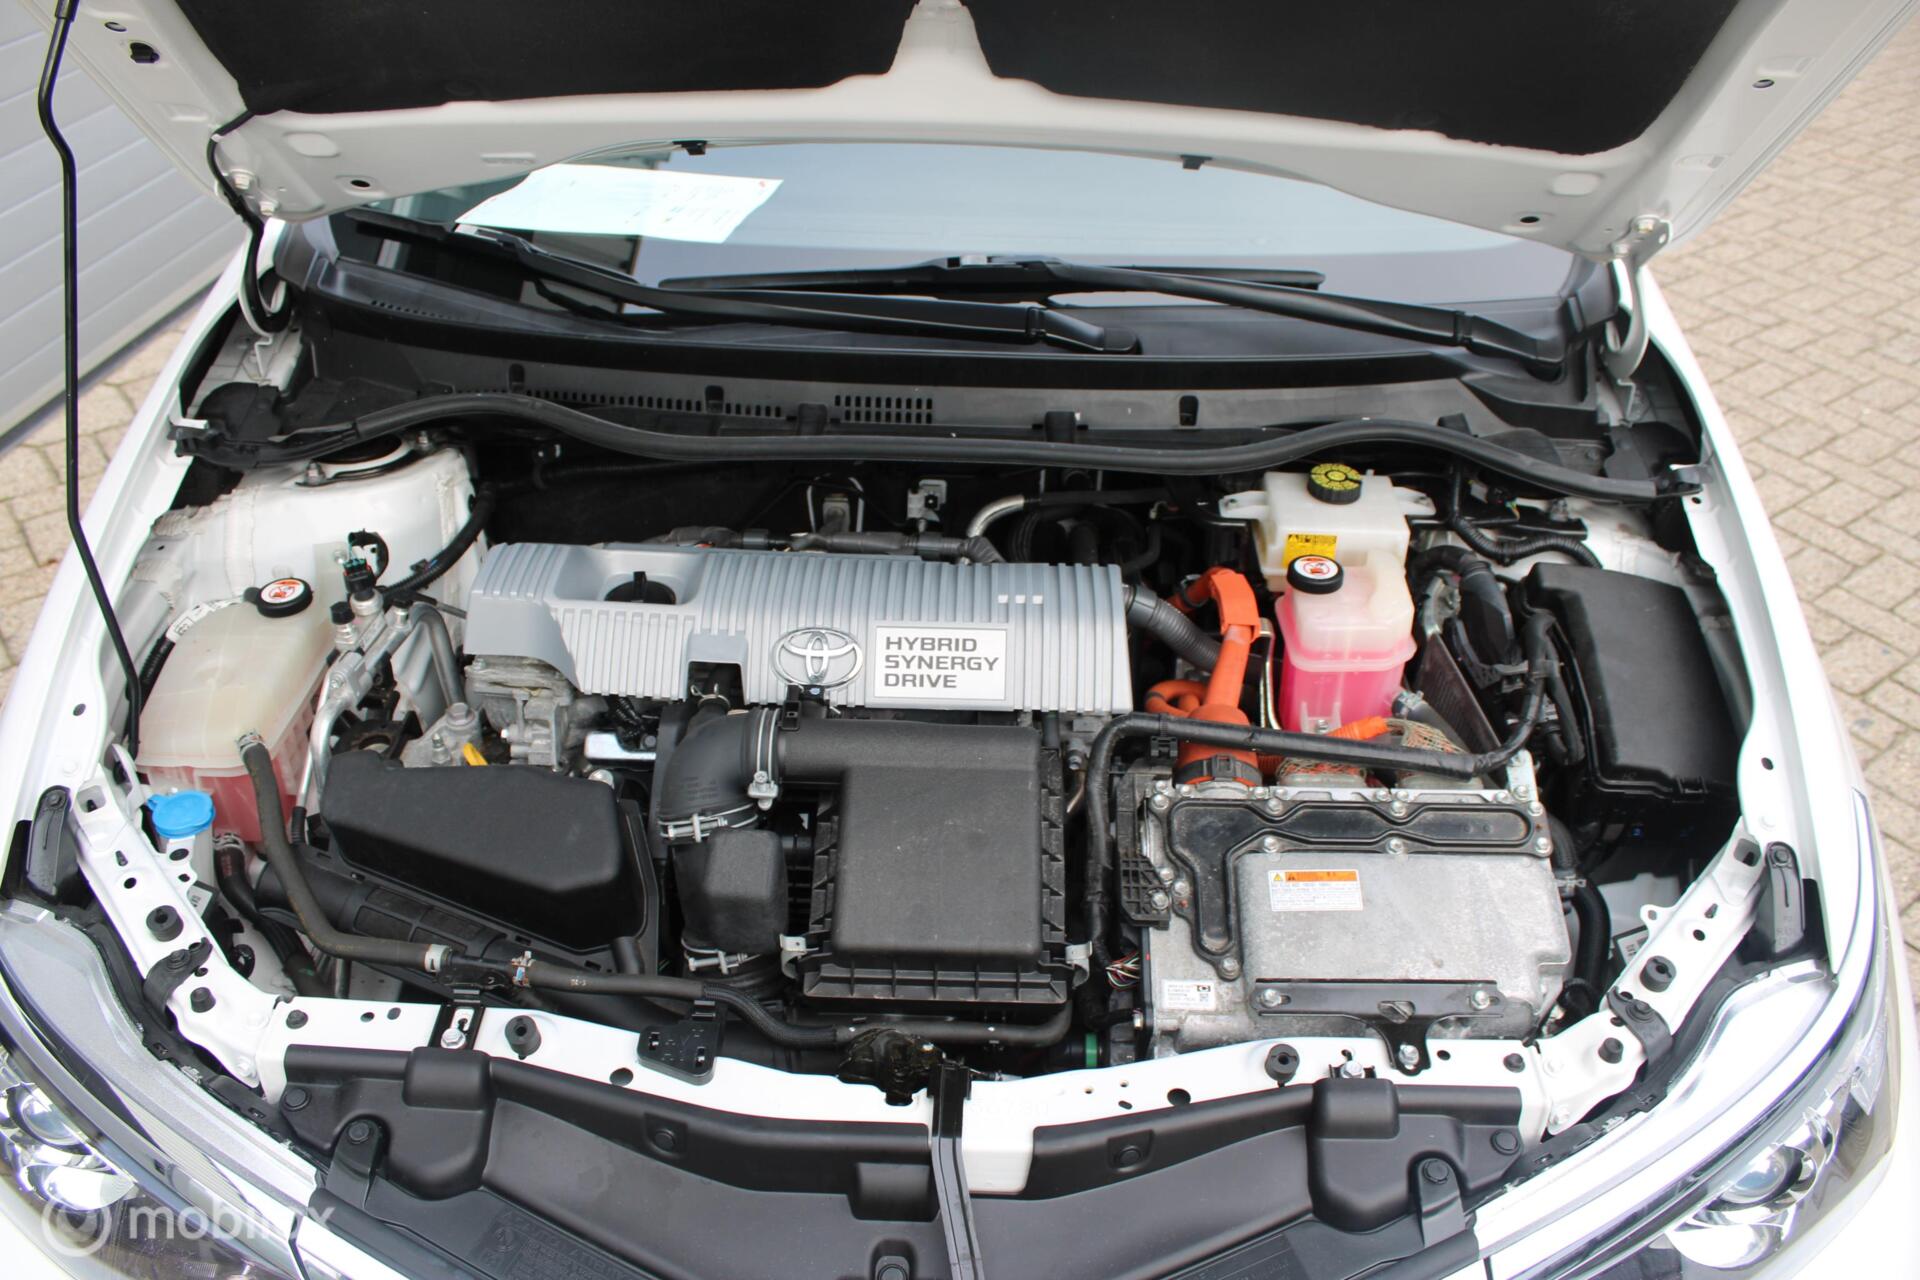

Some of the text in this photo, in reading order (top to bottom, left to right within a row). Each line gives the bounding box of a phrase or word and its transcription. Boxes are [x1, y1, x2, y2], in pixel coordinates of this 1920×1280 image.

[885, 636, 978, 653] HYBRID
[884, 654, 1000, 671] SYNERGY
[884, 672, 958, 689] DRIVE
